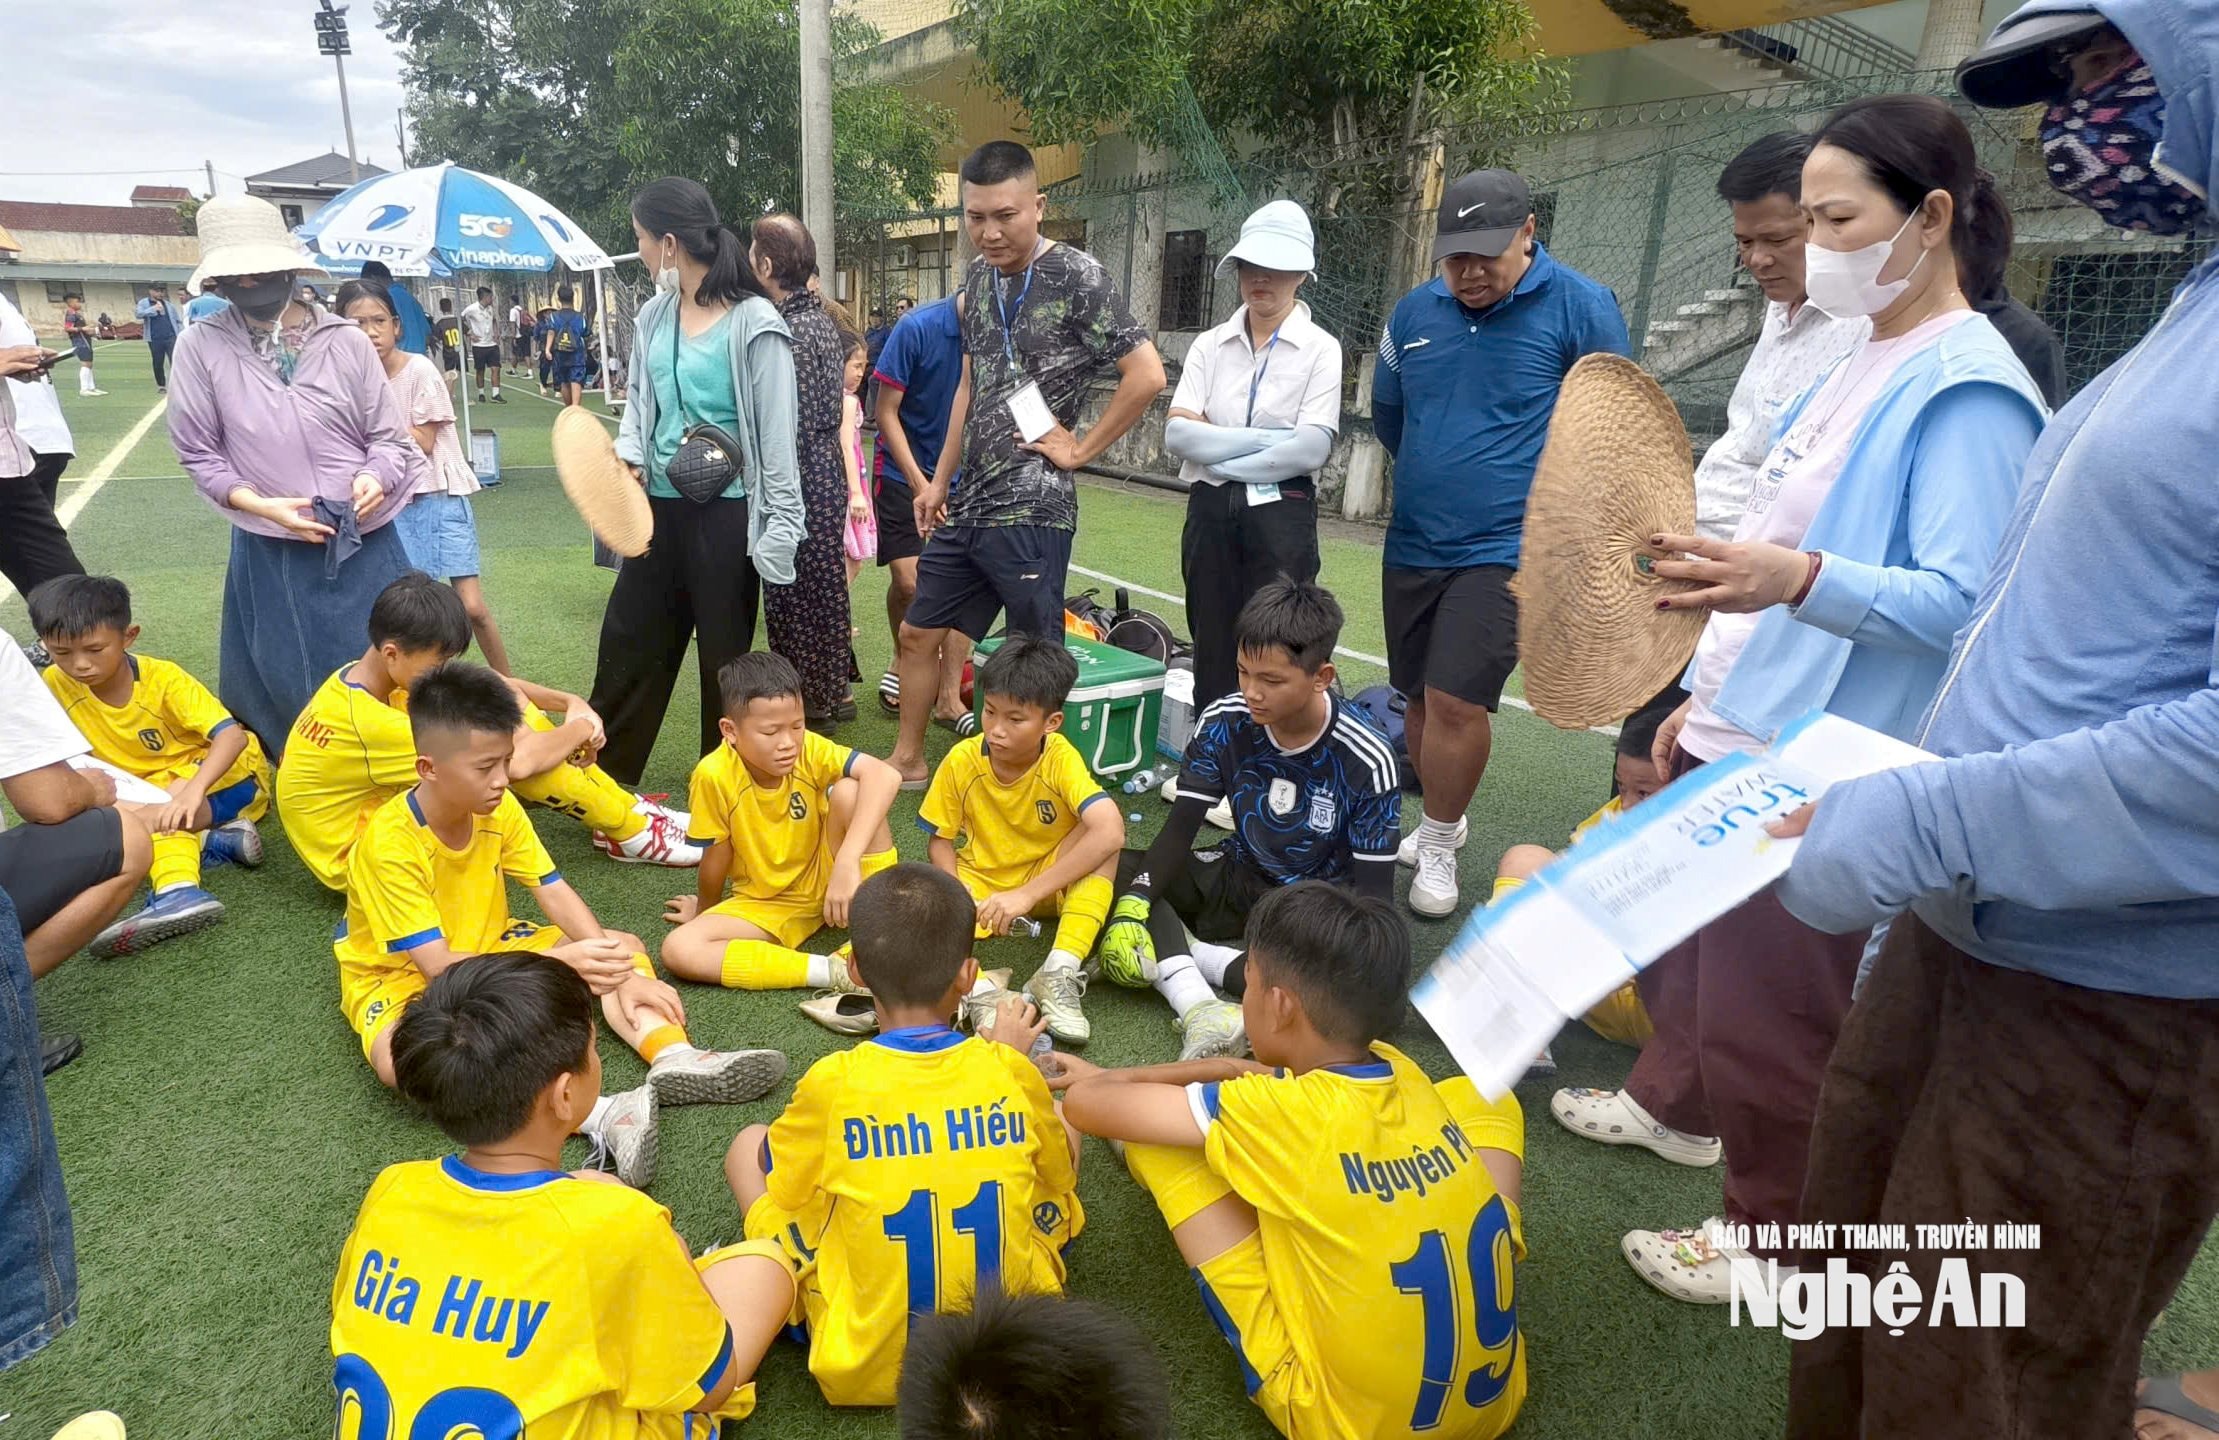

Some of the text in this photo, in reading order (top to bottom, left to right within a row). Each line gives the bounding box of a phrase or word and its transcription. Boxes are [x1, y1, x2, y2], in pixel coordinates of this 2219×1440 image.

[337, 240, 413, 260] VNPT
[445, 328, 460, 346] 10
[1690, 782, 1808, 848] true
[843, 1096, 1026, 1160] Đình Hiếu
[1339, 1144, 1457, 1203] Nguyên
[882, 1179, 1004, 1330] 11
[353, 1248, 551, 1359] Gia Huy
[1389, 1192, 1519, 1432] 19
